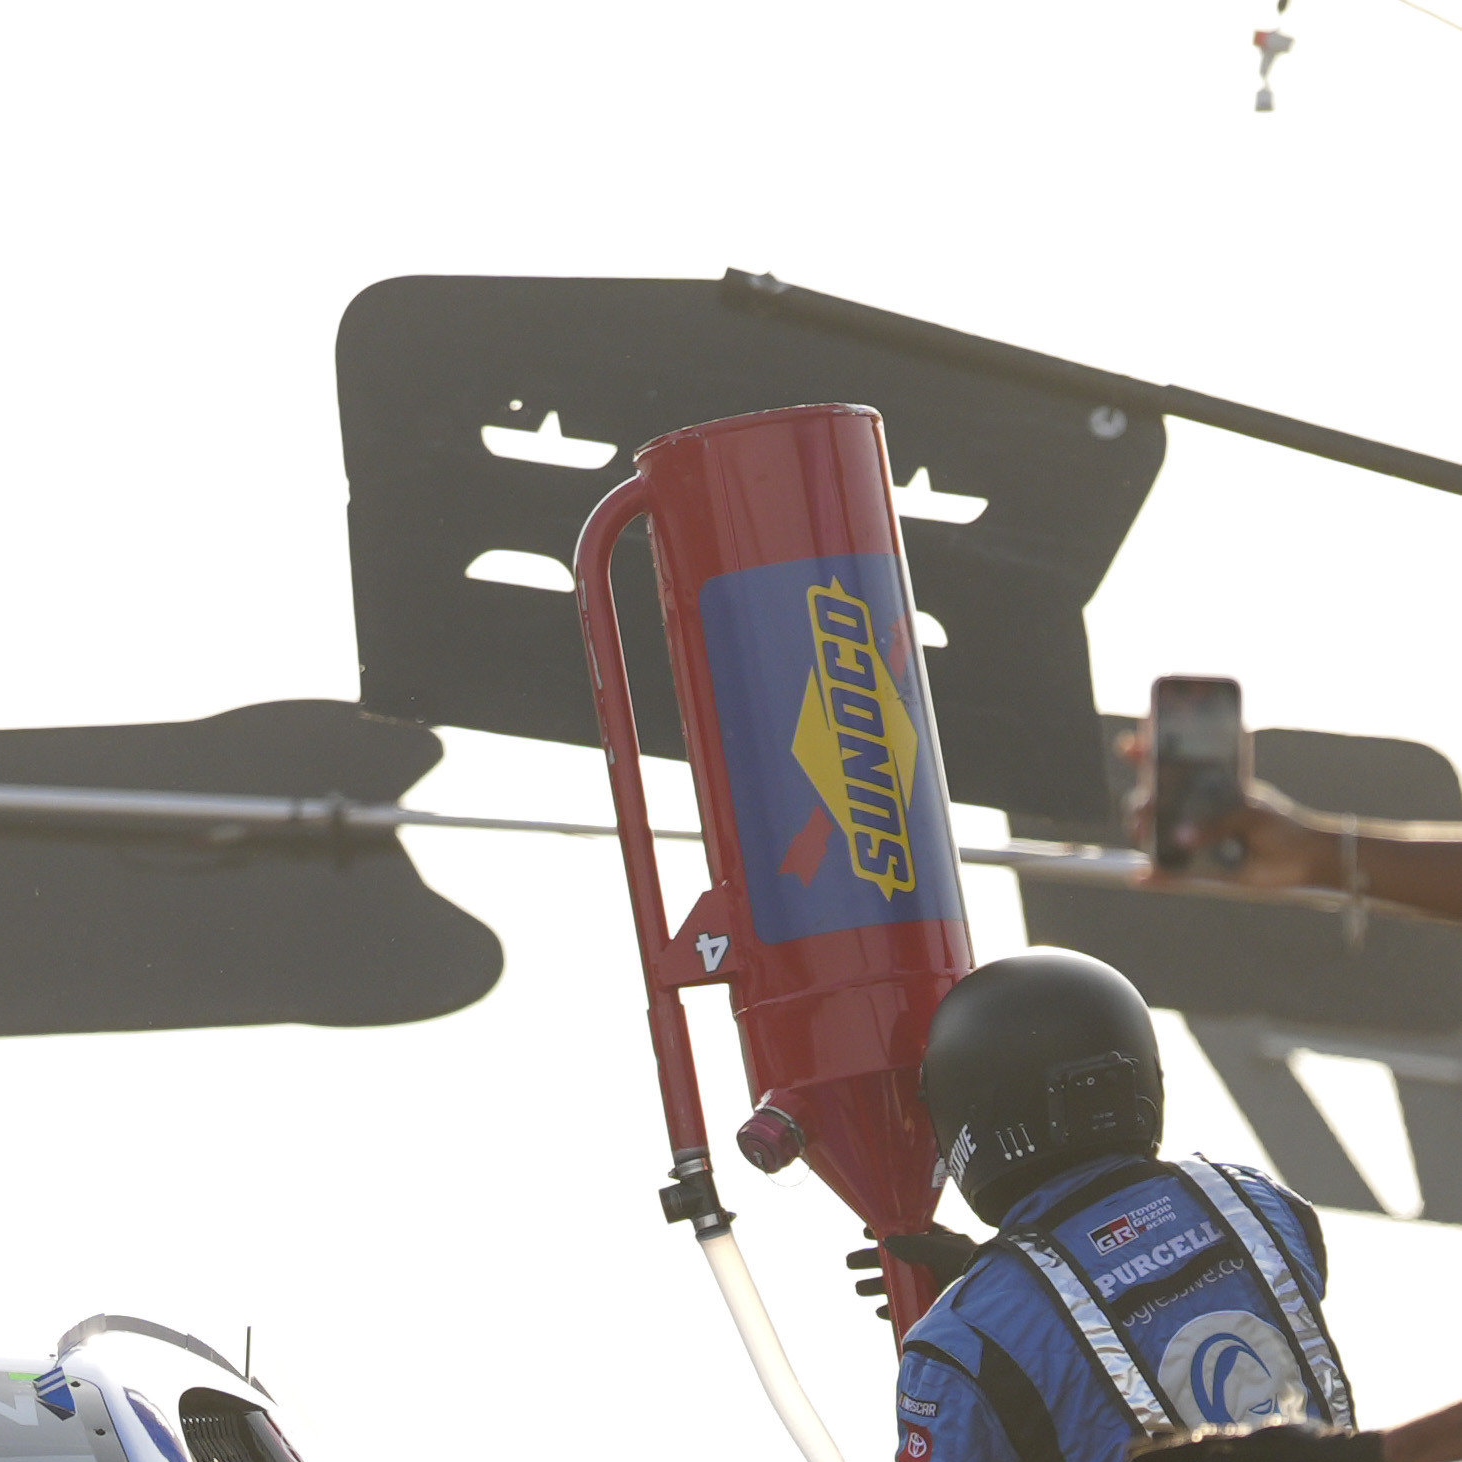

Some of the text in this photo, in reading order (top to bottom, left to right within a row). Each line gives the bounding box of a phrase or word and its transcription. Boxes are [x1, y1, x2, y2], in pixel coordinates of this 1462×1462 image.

[814, 597, 912, 884] SUNOCO
[694, 932, 730, 974] 4
[1129, 1195, 1171, 1219] TOYOTA
[1132, 1204, 1172, 1228] GAZOO
[1096, 1225, 1134, 1251] GR
[1093, 1220, 1226, 1298] PURCELL
